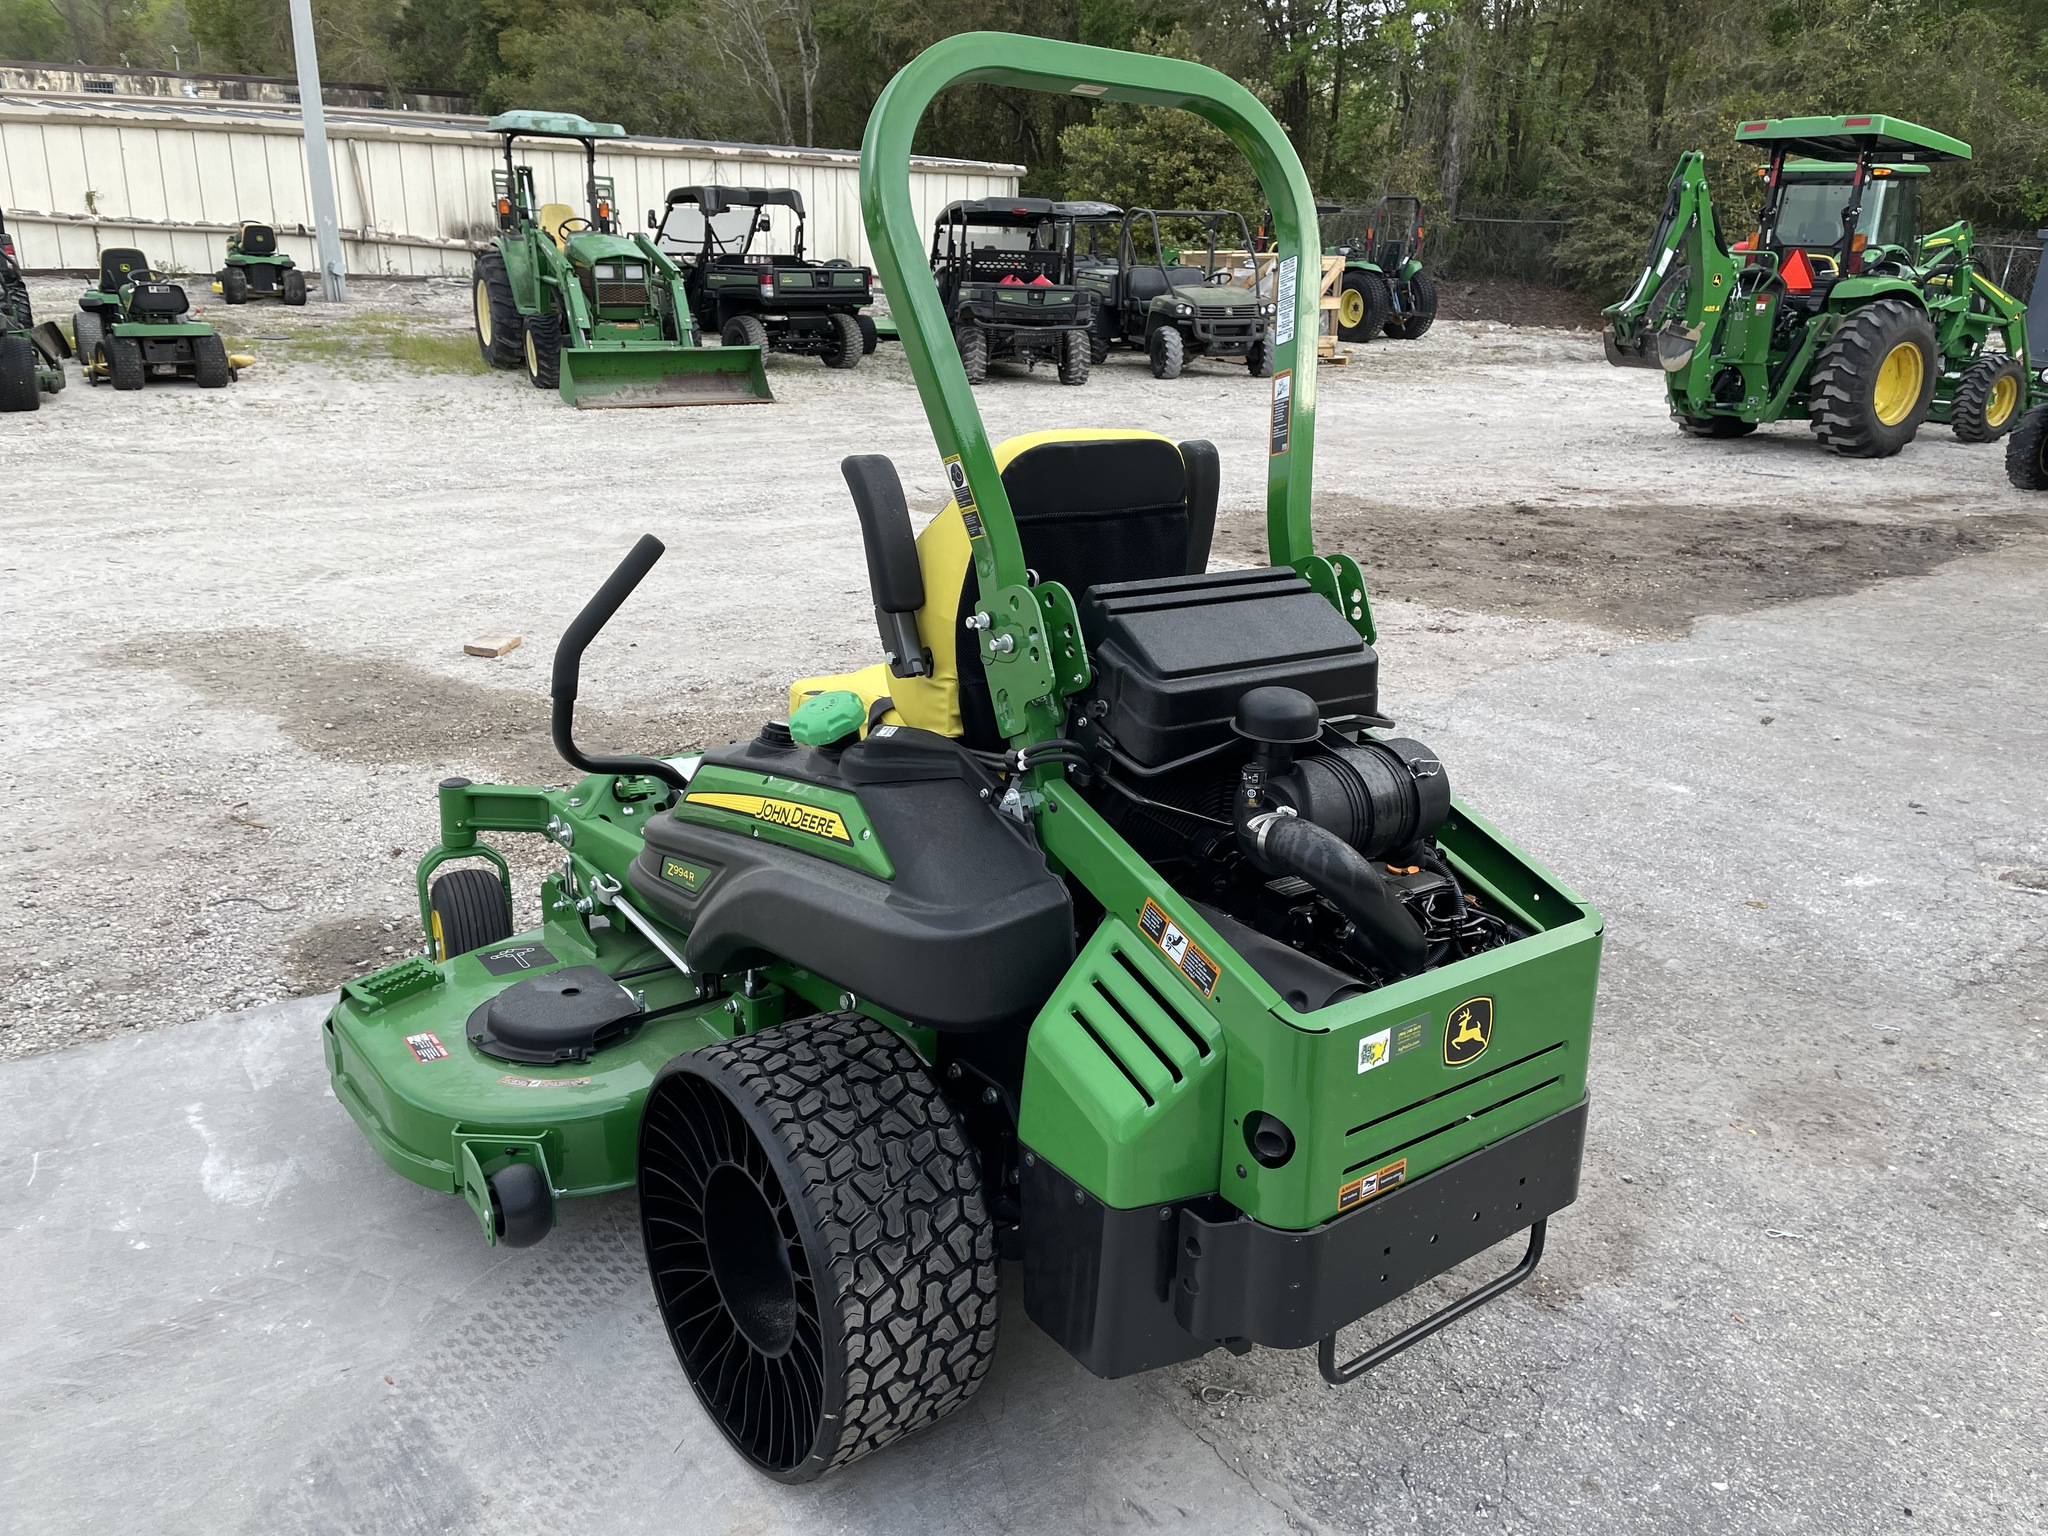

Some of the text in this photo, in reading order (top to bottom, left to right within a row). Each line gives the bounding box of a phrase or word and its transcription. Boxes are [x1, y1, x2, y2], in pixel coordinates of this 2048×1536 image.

[755, 799, 837, 835] JOHN DEERE
[667, 863, 695, 882] Z994R
